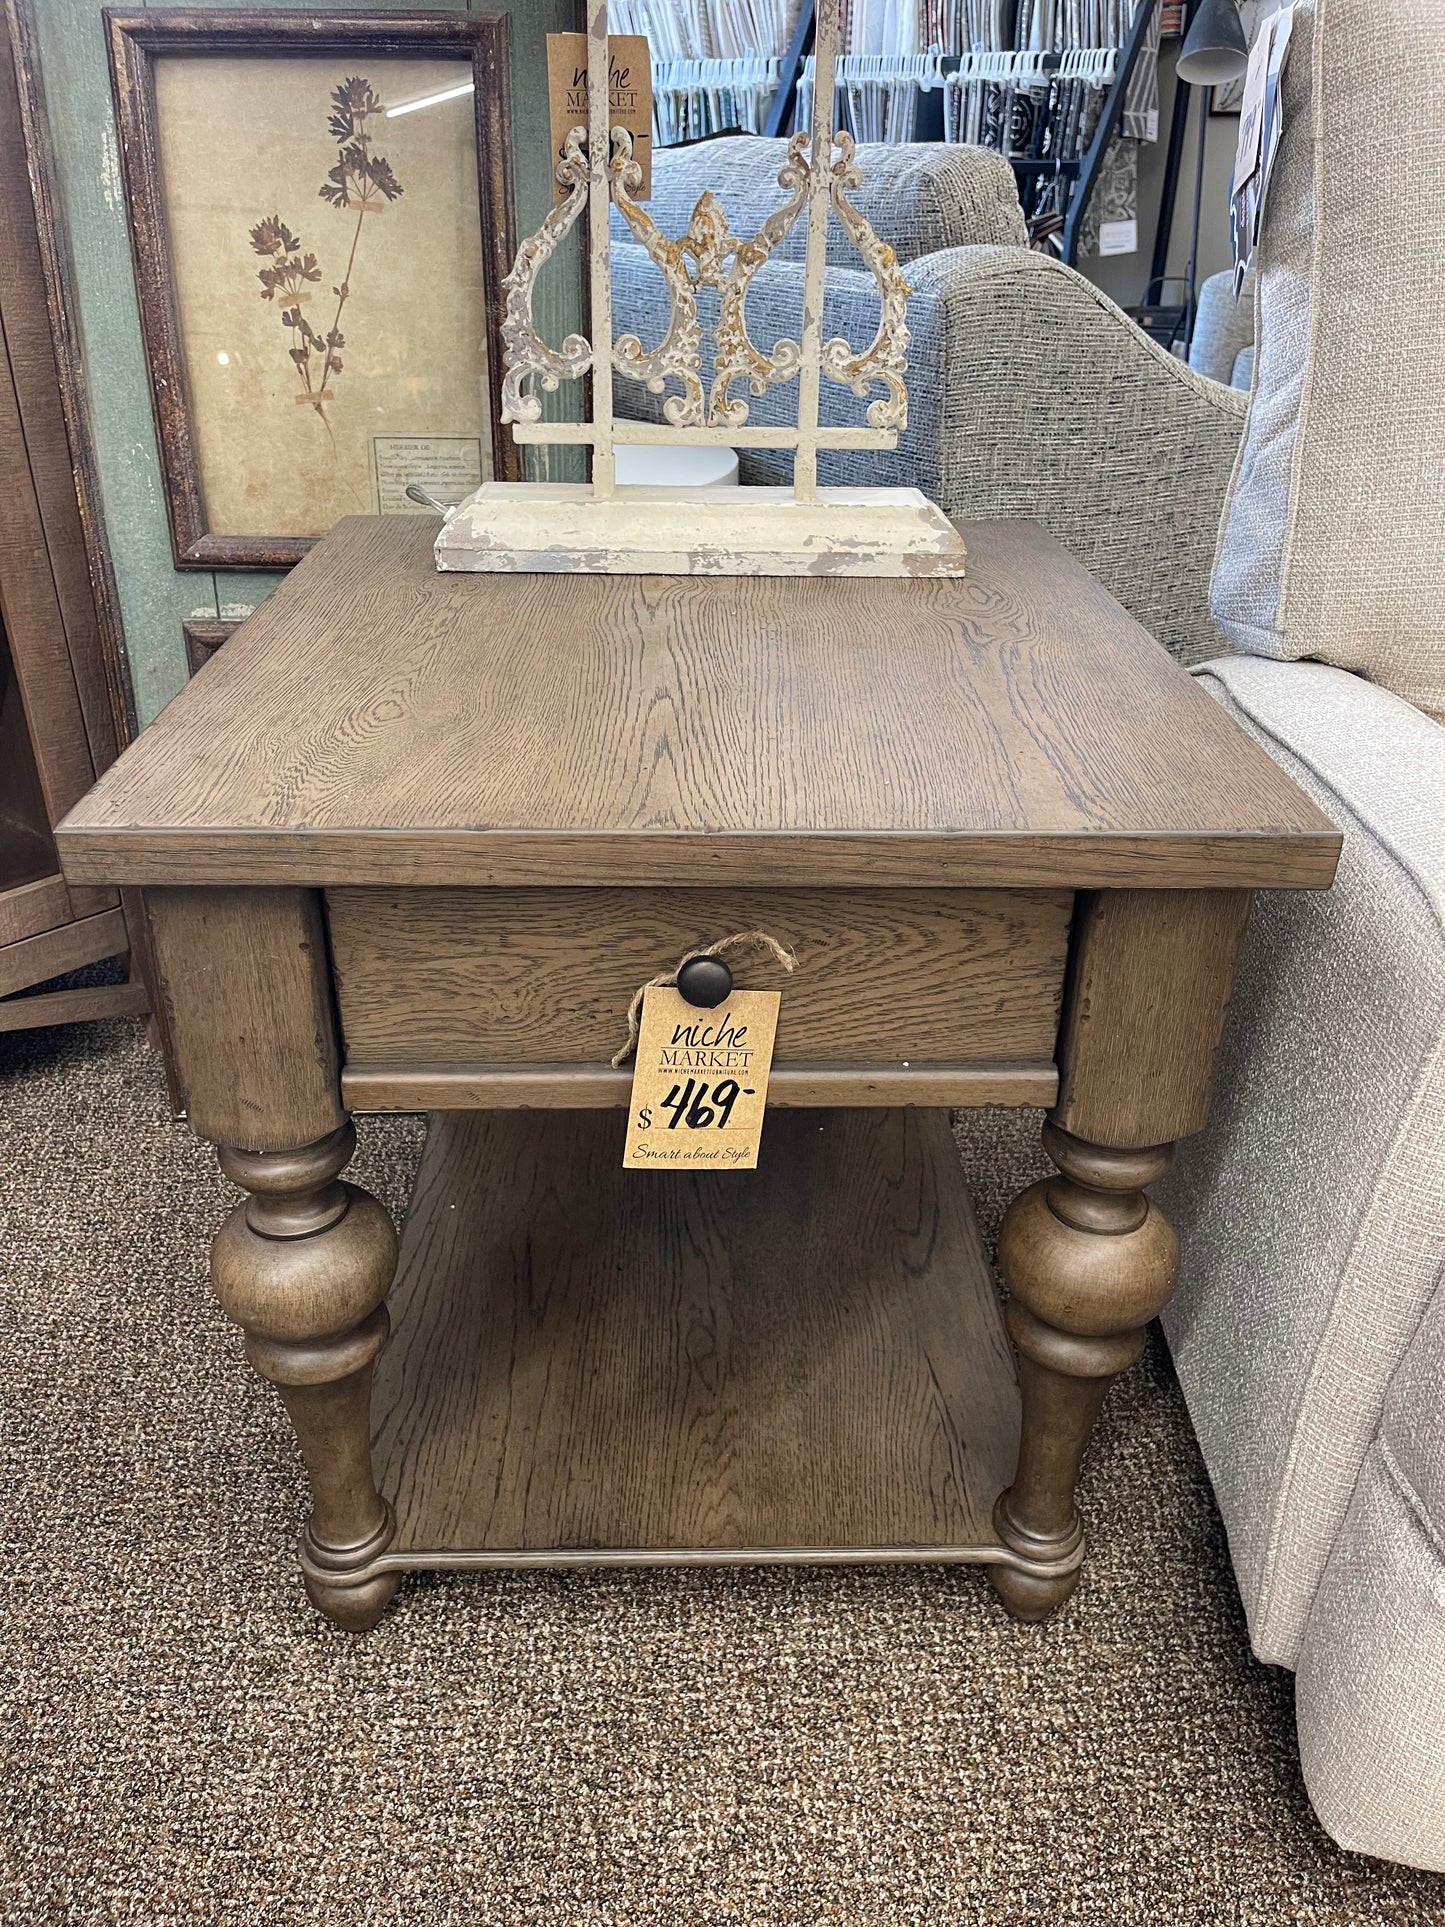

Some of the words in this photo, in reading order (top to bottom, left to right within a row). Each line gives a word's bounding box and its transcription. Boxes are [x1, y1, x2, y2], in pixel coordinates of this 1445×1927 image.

[573, 55, 631, 88] nhe
[567, 92, 637, 106] MAKET
[671, 1012, 748, 1047] niche
[659, 1050, 754, 1067] MARKET
[637, 1104, 653, 1130] $
[632, 1143, 680, 1159] Smart
[683, 1146, 719, 1159] about
[721, 1146, 751, 1164] Style
